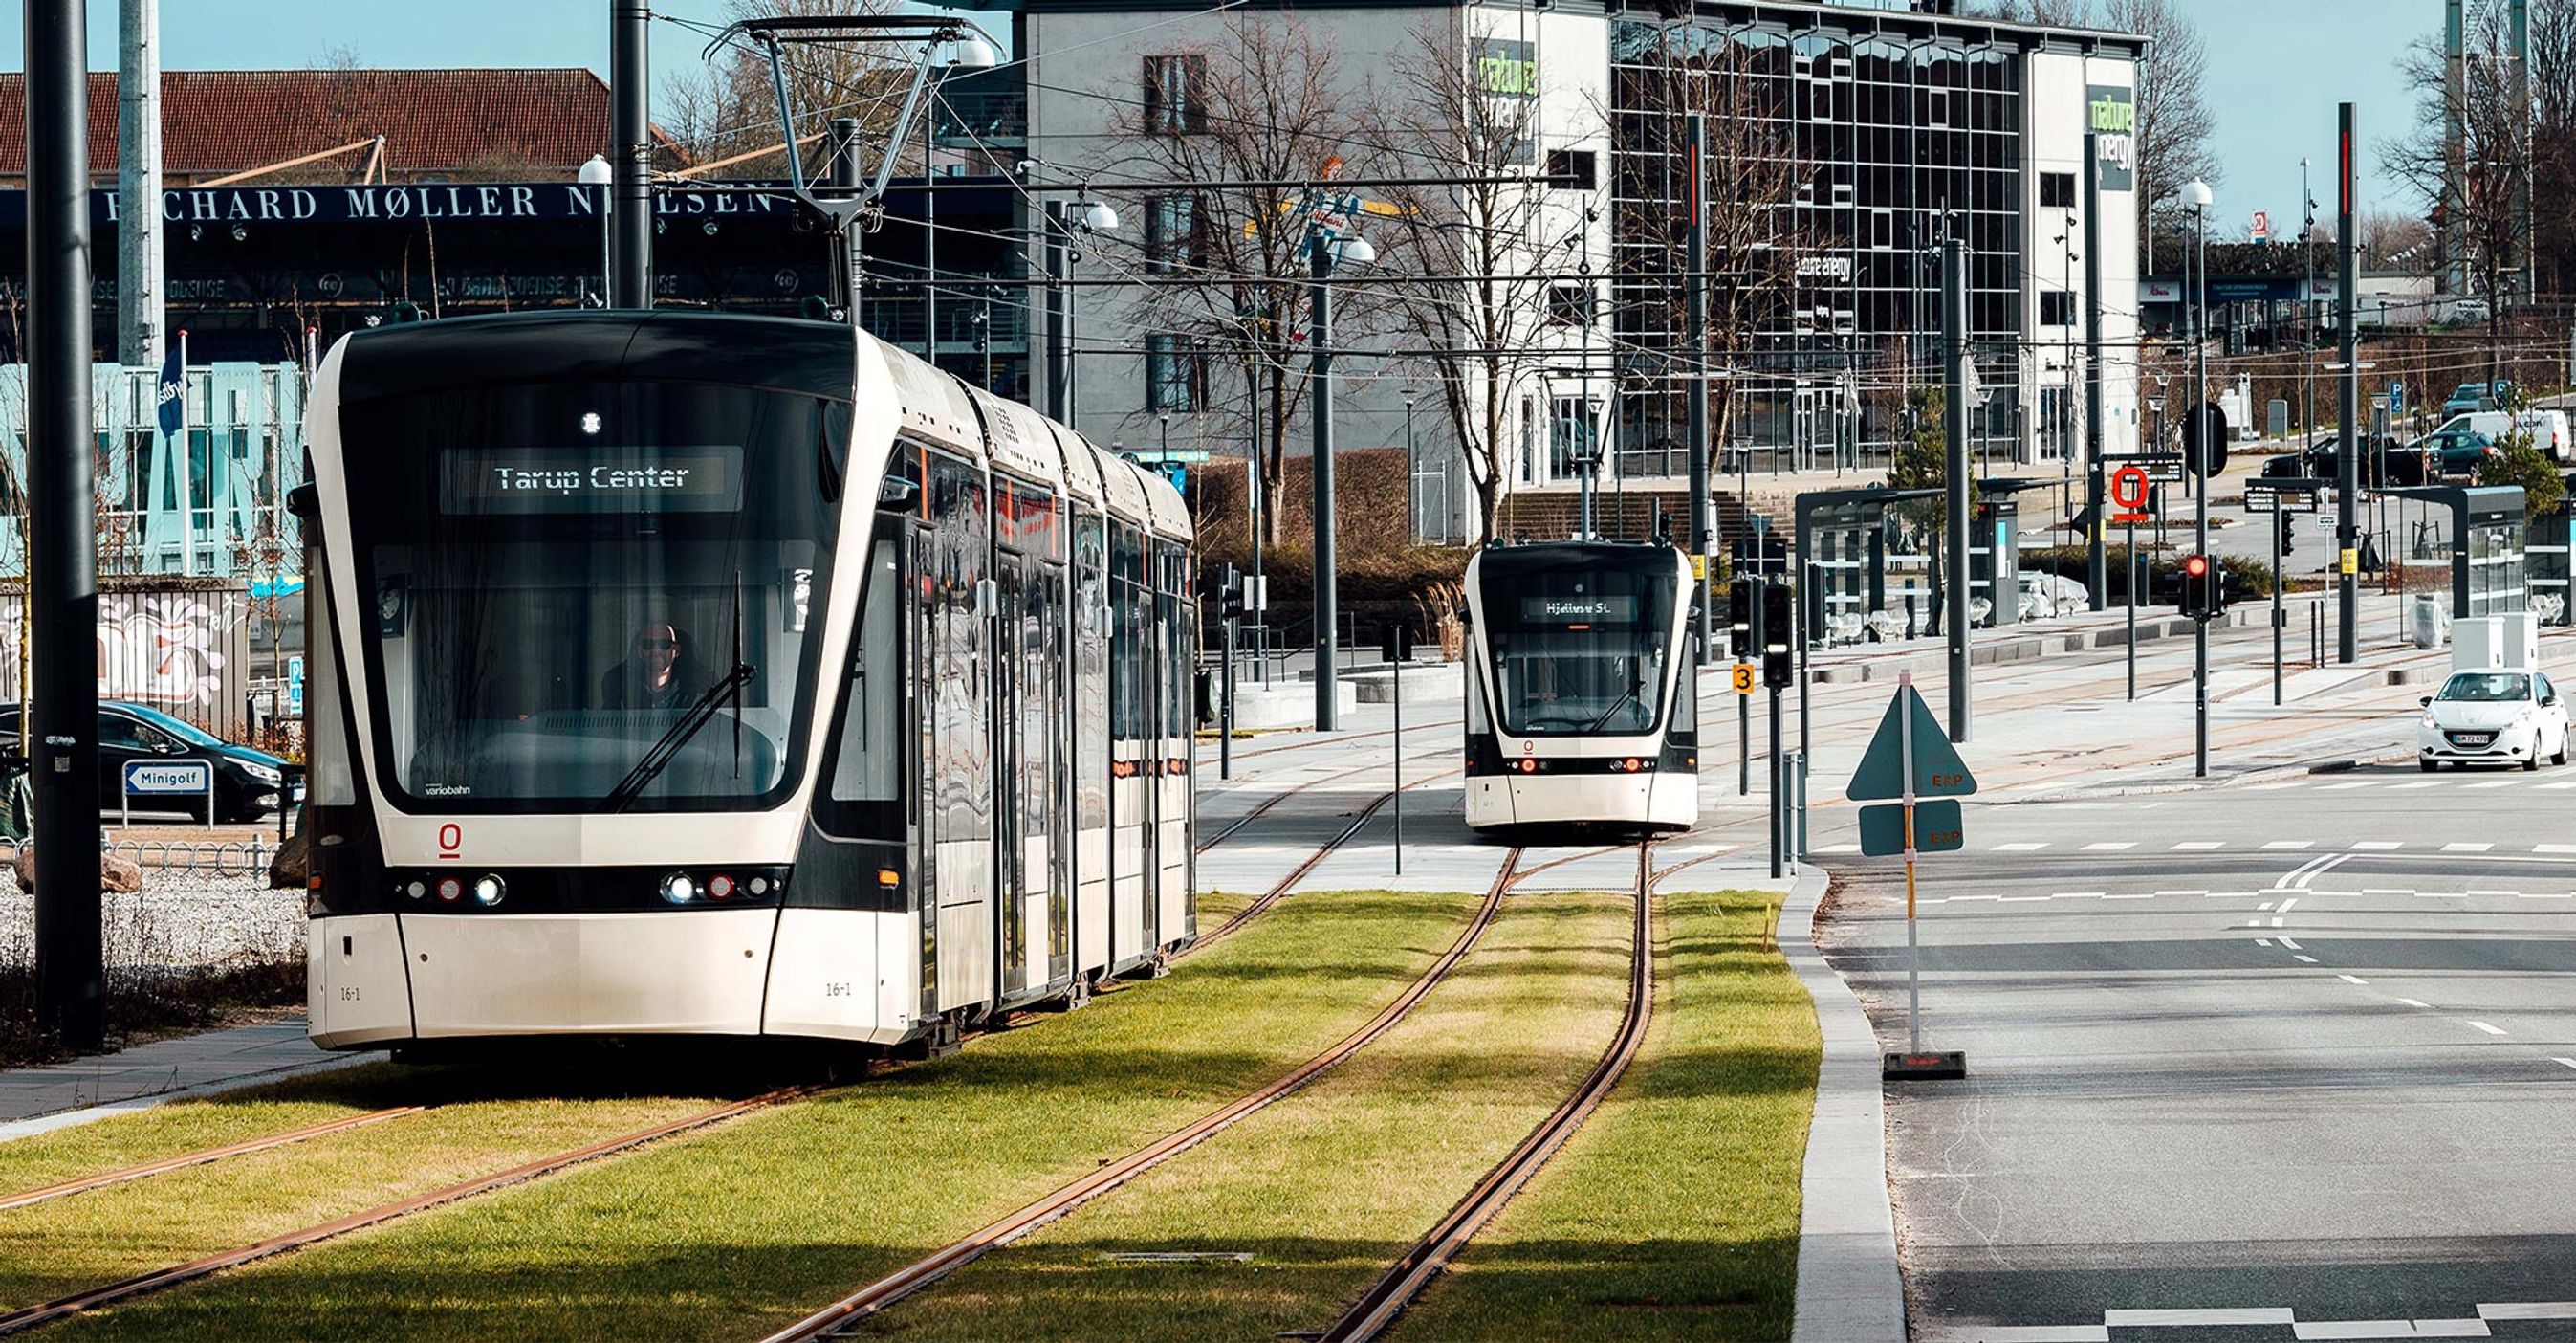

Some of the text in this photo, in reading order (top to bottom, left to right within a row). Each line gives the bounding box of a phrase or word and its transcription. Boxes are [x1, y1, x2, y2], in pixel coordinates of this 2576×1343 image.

[2089, 94, 2132, 132] nature
[2098, 134, 2133, 171] nergy
[103, 184, 772, 222] CHARD MØLLER NLSEN
[2393, 384, 2402, 395] P
[494, 465, 689, 495] Tarup Center
[1736, 668, 1751, 690] 3
[142, 772, 197, 786] Minigolf
[340, 987, 360, 1001] 16-1
[826, 982, 851, 997] 16-1
